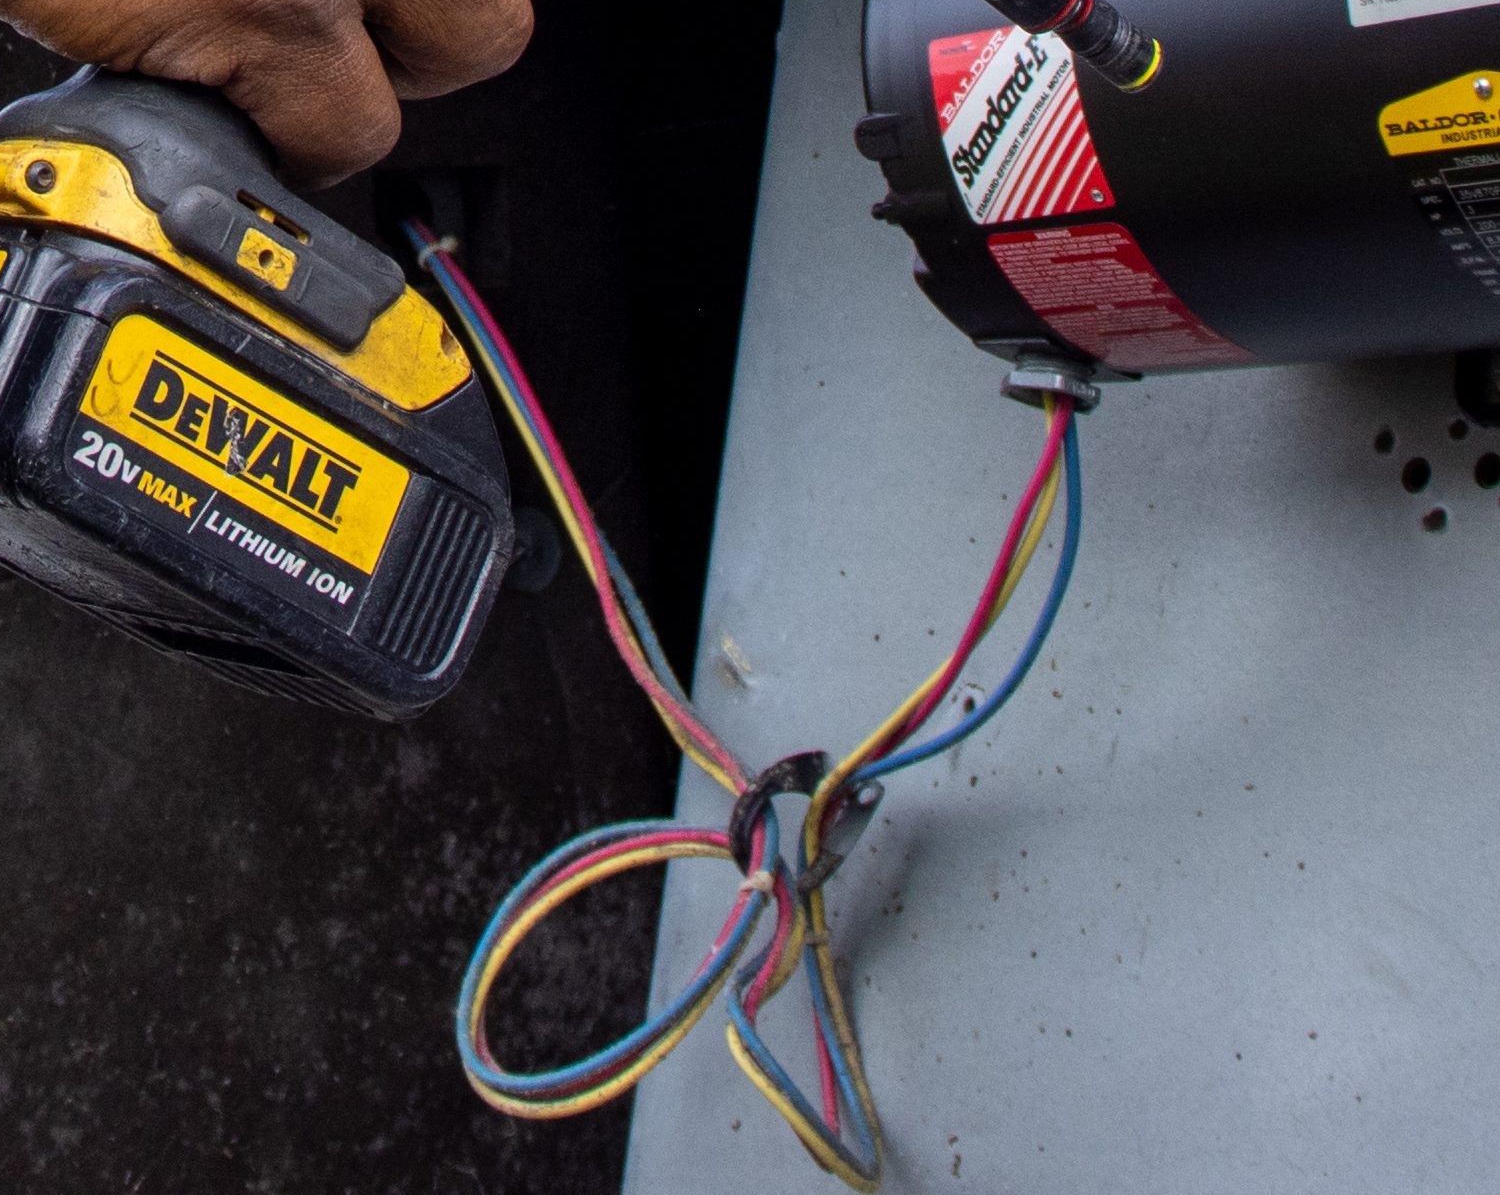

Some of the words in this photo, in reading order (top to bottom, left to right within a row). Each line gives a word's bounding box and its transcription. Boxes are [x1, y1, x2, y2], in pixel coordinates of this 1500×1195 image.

[941, 30, 1006, 125] BALDOR
[1018, 92, 1050, 139] INDUSTRIAL
[1047, 59, 1071, 91] MOTOR
[1385, 111, 1490, 137] BALDOR
[137, 470, 199, 518] MAX
[204, 510, 307, 578] LITHIUM
[306, 567, 354, 606] ION
